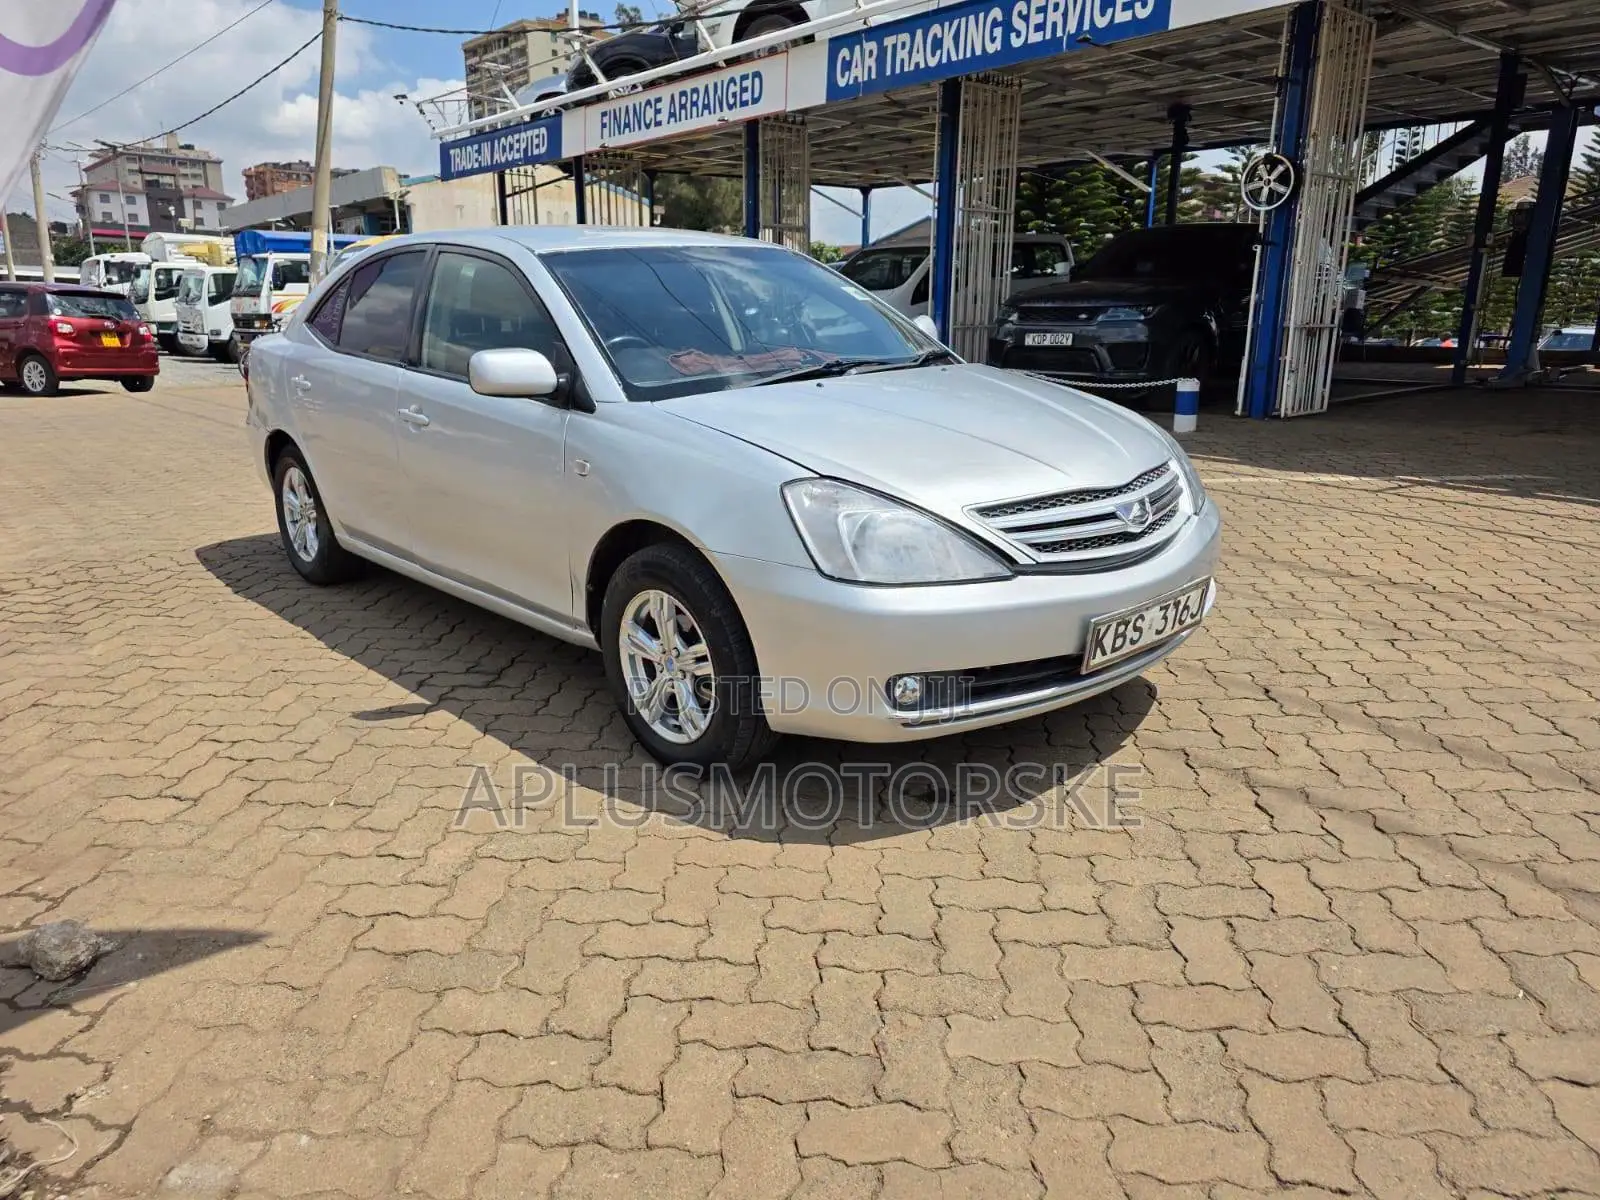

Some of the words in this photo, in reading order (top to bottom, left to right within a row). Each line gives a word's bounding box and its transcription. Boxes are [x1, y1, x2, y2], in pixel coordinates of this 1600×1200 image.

[836, 40, 877, 88] CAR
[883, 7, 1003, 77] TRACKING
[600, 96, 662, 139] FINANCE
[667, 70, 764, 124] ARRANGED
[449, 141, 491, 173] TRADE-IN
[493, 126, 548, 164] ACCEPTED
[1050, 334, 1072, 345] 002Y
[1092, 613, 1146, 660] KBS
[1155, 587, 1206, 636] 316J
